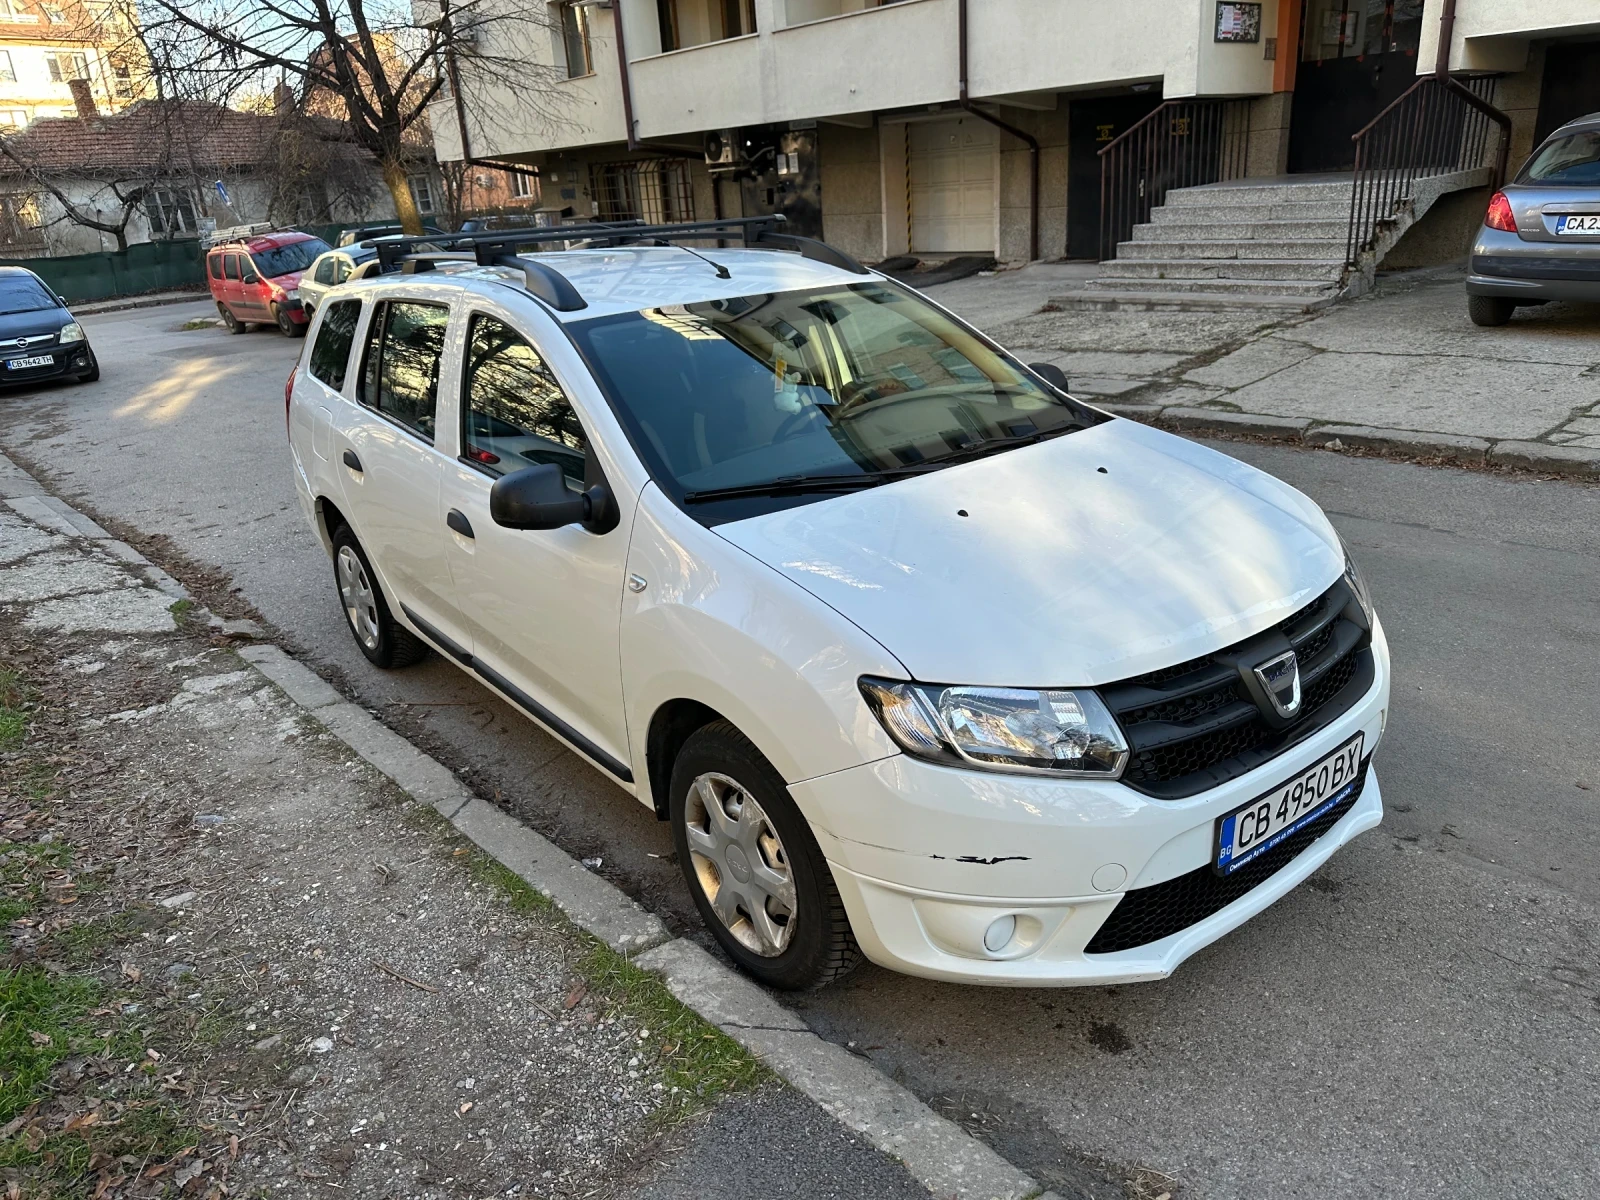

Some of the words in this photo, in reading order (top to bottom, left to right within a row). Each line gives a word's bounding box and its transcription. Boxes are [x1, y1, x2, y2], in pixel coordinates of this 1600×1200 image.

[1566, 217, 1585, 230] CA
[11, 360, 23, 368] CB
[23, 357, 42, 367] 9642
[41, 356, 53, 364] TH
[1238, 802, 1271, 848] CB
[1275, 765, 1329, 824] 4950
[1330, 742, 1359, 791] BX
[1220, 844, 1232, 859] BG
